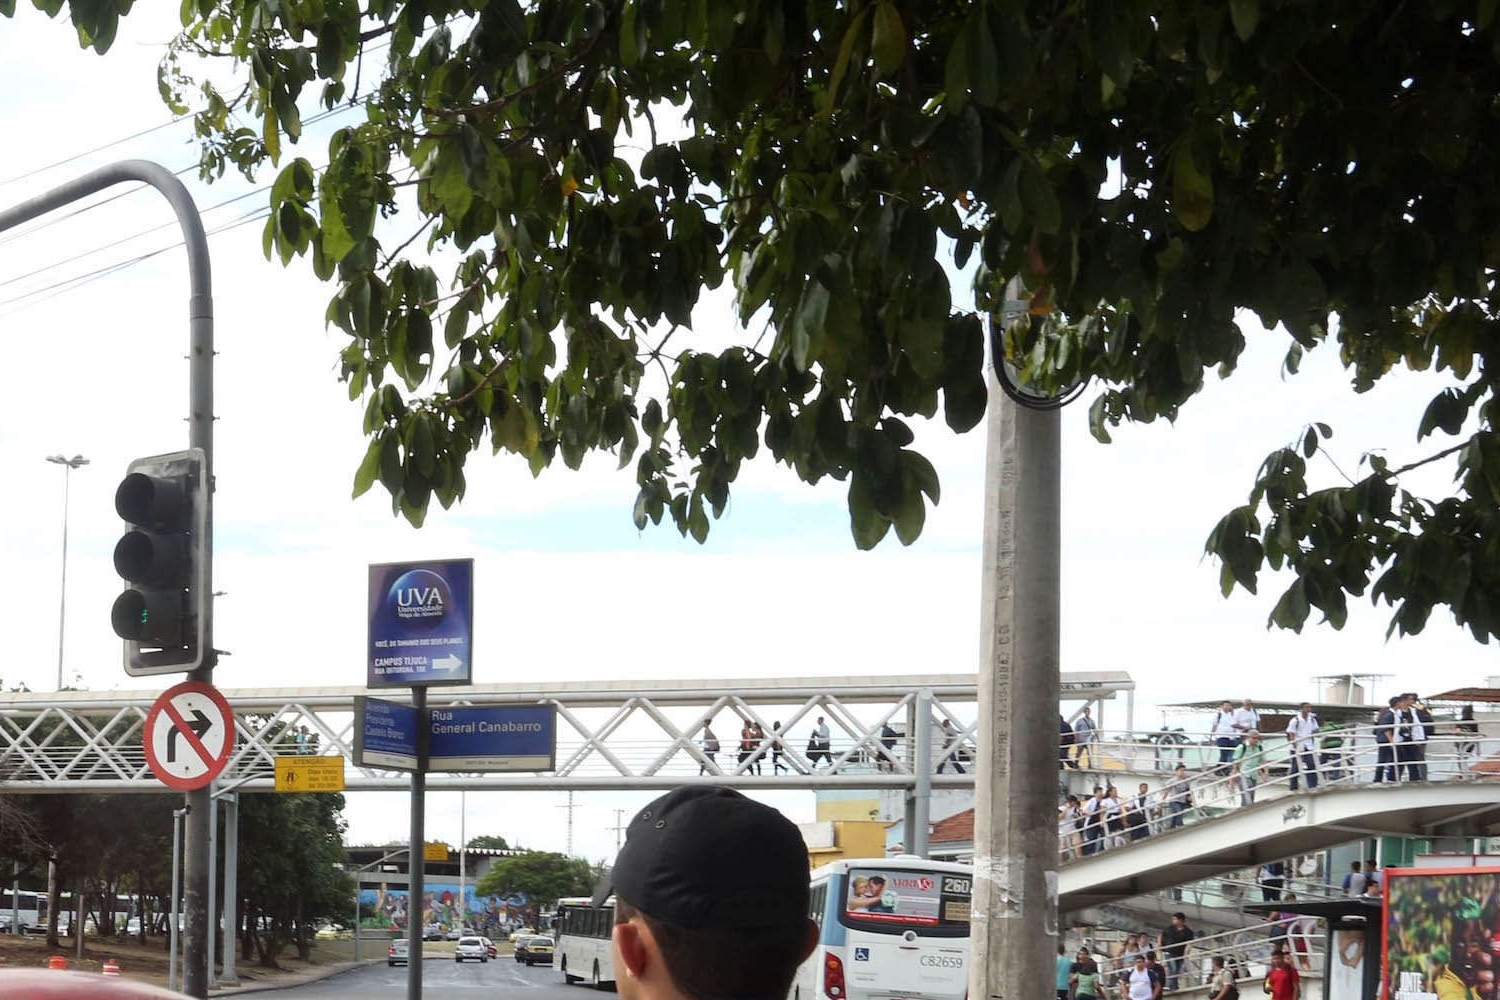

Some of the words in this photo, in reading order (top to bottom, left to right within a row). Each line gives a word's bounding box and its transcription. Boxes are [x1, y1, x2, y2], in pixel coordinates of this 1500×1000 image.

[397, 587, 444, 607] UVA
[398, 604, 443, 613] Universidade
[374, 657, 403, 667] CAMPUS
[404, 656, 427, 665] TIJUCA
[374, 667, 385, 675] RUA
[432, 710, 453, 721] Rua
[432, 722, 476, 734] General
[478, 721, 542, 733] Canabarro
[944, 878, 970, 893] 260
[920, 955, 963, 968] C82659
